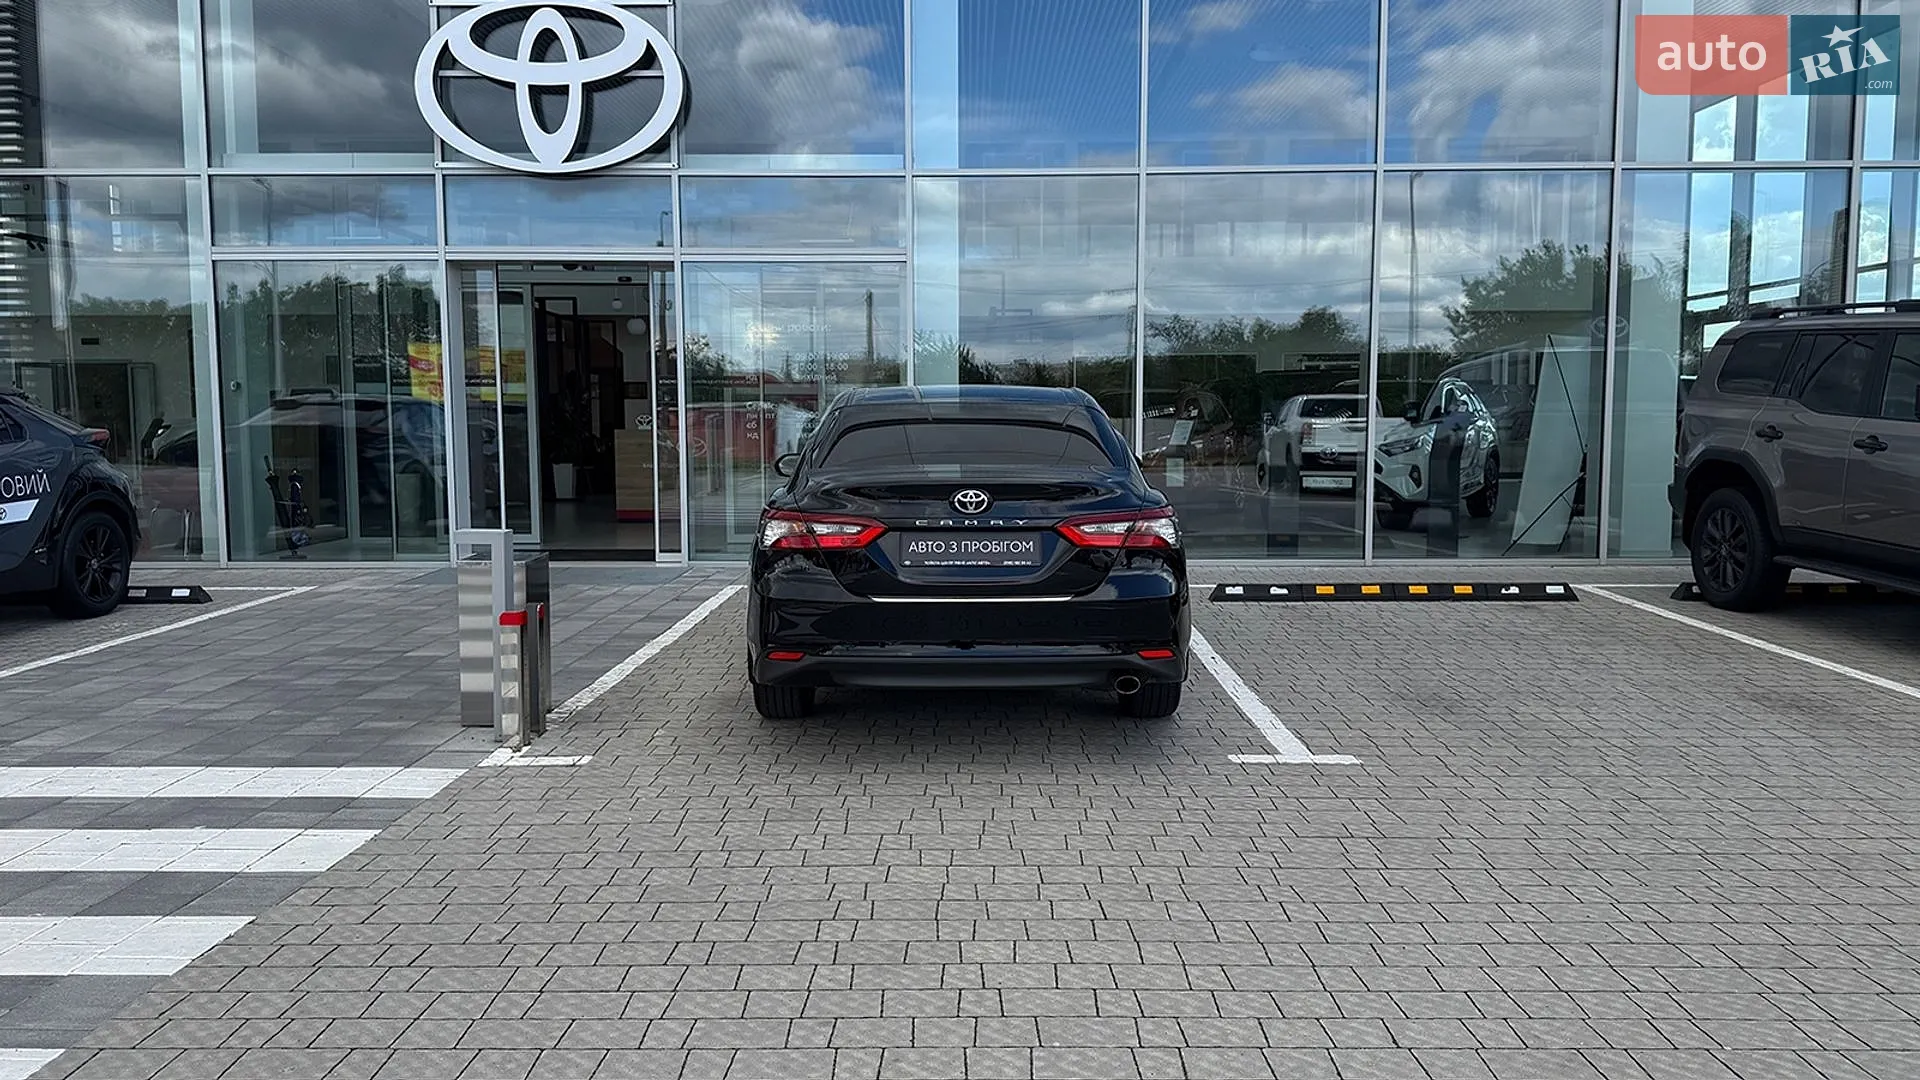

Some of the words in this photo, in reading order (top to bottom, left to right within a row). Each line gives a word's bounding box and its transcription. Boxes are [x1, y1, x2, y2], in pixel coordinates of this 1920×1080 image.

[1, 468, 51, 498] ОВИЙ
[908, 540, 946, 553] АВТО
[948, 540, 958, 553] З
[961, 540, 1034, 553] ПРОБІГОМ
